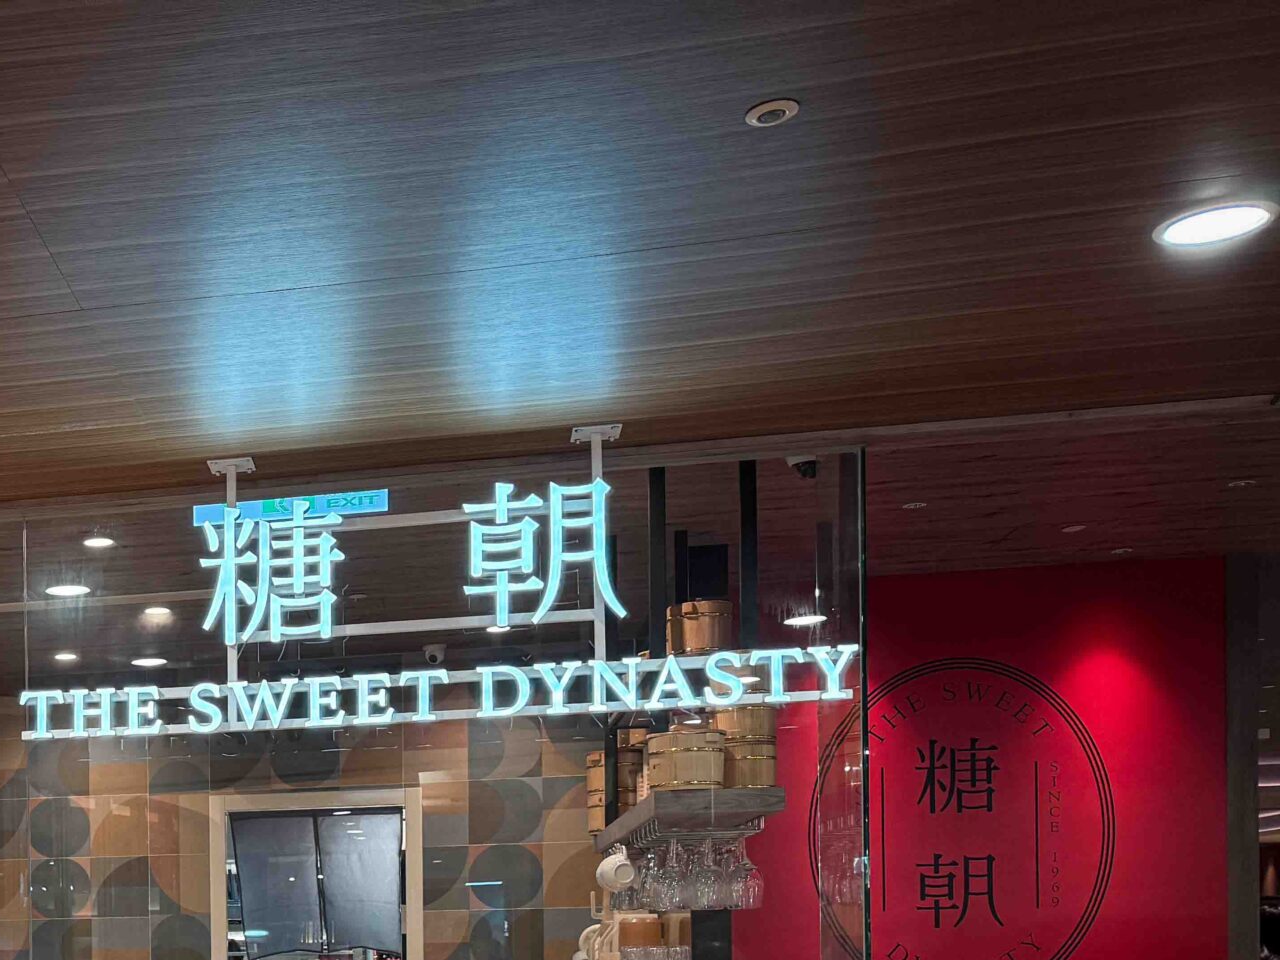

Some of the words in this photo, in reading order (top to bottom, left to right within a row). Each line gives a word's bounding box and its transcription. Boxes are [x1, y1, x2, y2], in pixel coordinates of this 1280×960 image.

[326, 494, 380, 509] EXIT
[200, 477, 627, 646] 糖朝
[19, 687, 164, 741] THE
[188, 669, 449, 733] SWEET
[476, 643, 860, 720] DYNASTY
[869, 694, 925, 743] THE
[943, 682, 1053, 737] SWEET
[915, 738, 1005, 930] 糖朝
[1048, 760, 1062, 834] SINCE
[1049, 850, 1061, 908] 1969
